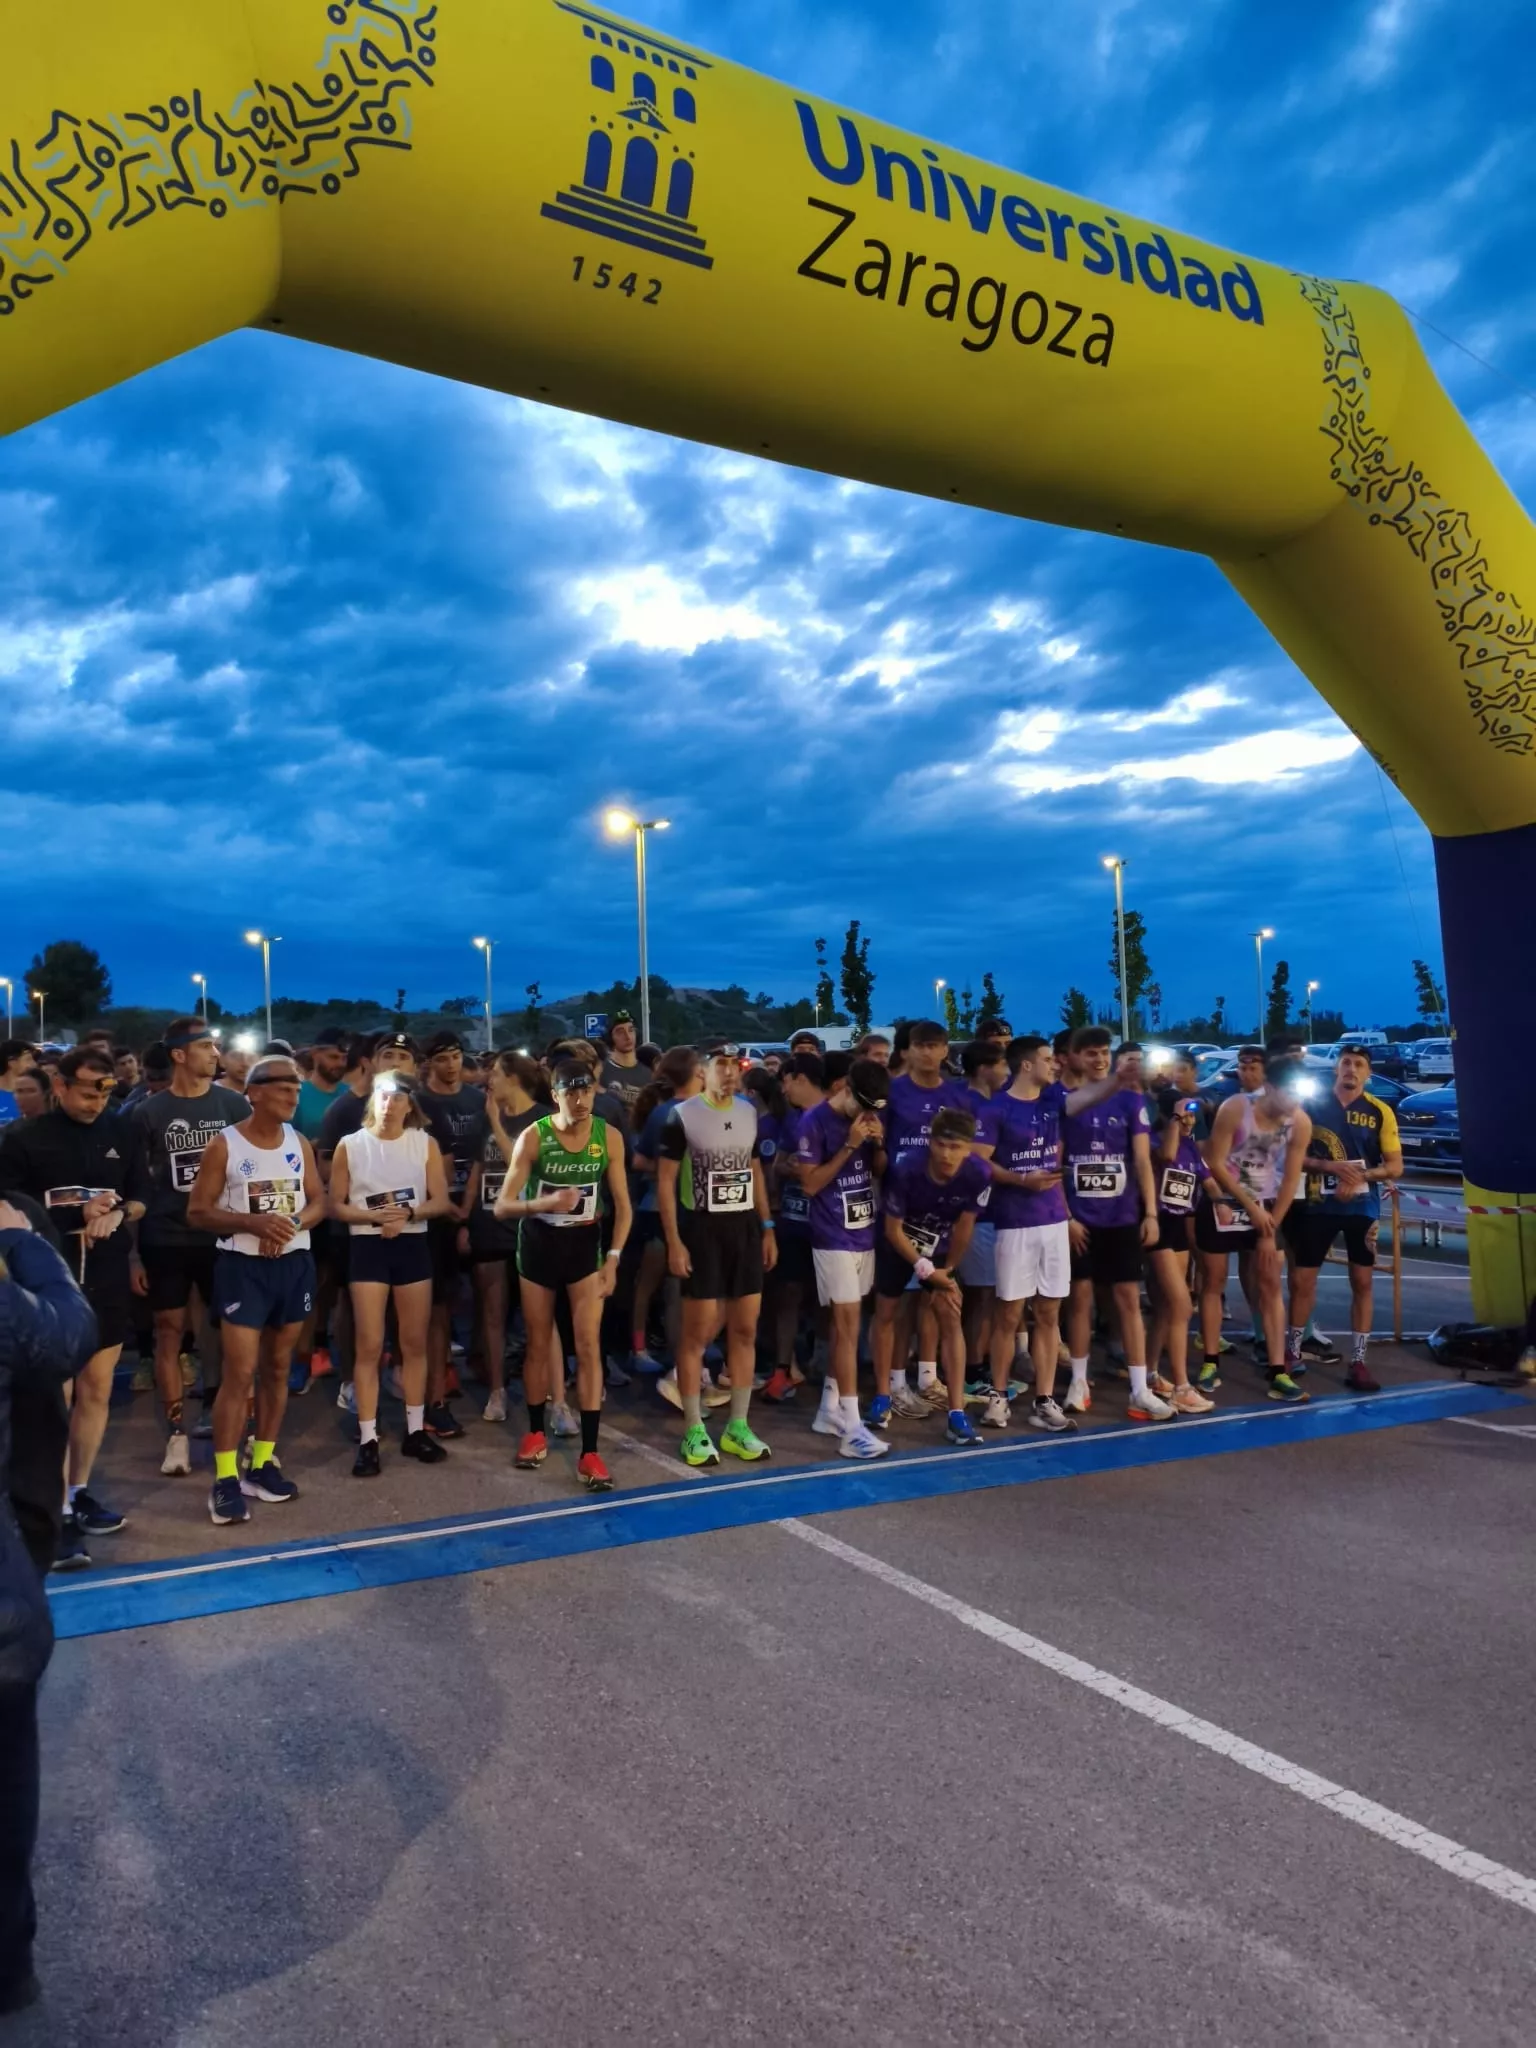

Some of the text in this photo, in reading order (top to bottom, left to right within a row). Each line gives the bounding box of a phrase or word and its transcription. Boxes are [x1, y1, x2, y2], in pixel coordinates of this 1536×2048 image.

[794, 98, 1265, 327] Universidad
[573, 255, 662, 305] 1542
[797, 197, 1117, 368] Zaragoza
[199, 1120, 227, 1129] Carrera
[1346, 1111, 1376, 1128] 1306
[545, 1162, 601, 1173] Huesca
[1082, 1176, 1112, 1187] 704
[1169, 1182, 1189, 1196] 699
[718, 1185, 744, 1200] 567
[259, 1195, 288, 1210] 571
